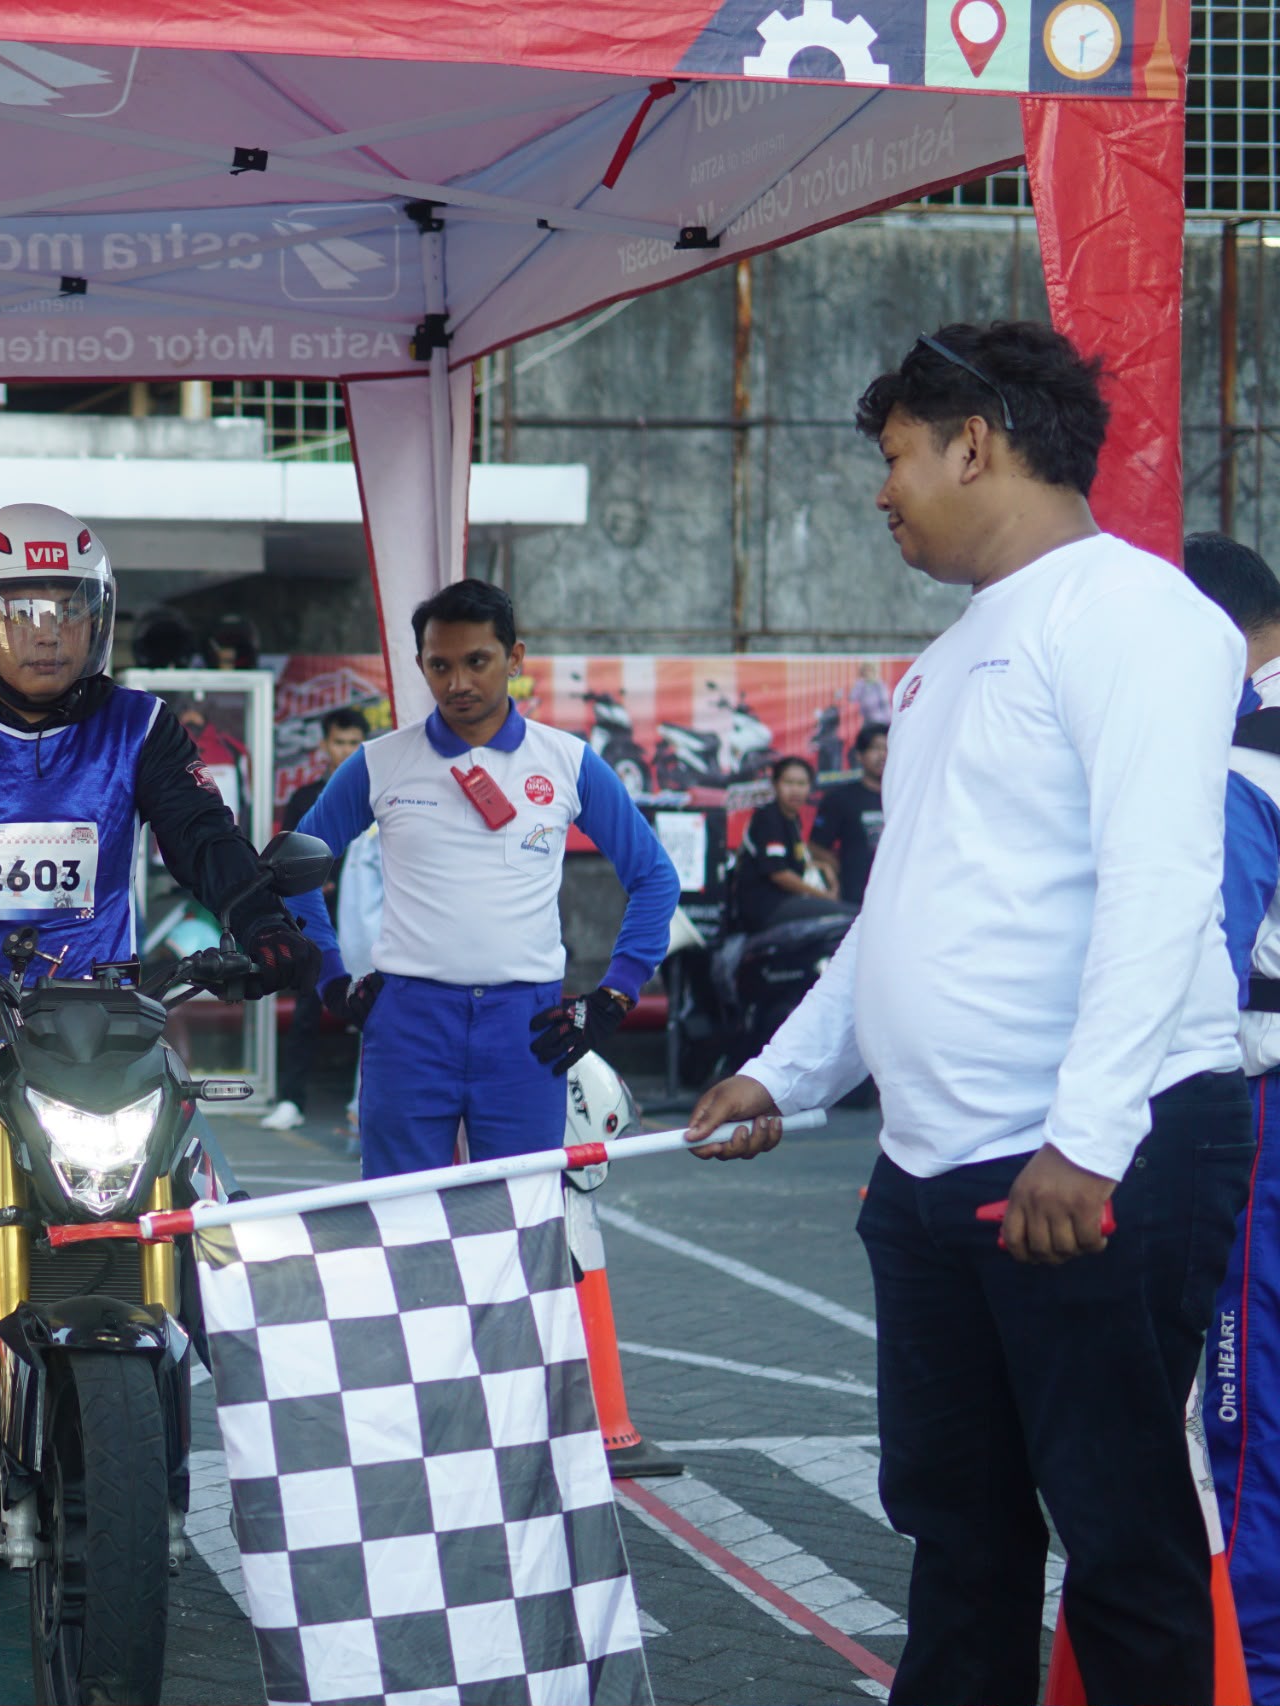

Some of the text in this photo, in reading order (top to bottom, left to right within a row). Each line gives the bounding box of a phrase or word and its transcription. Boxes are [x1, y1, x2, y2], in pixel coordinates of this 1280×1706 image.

[28, 547, 65, 563] VIP
[1217, 1310, 1238, 1423] One HEART.
